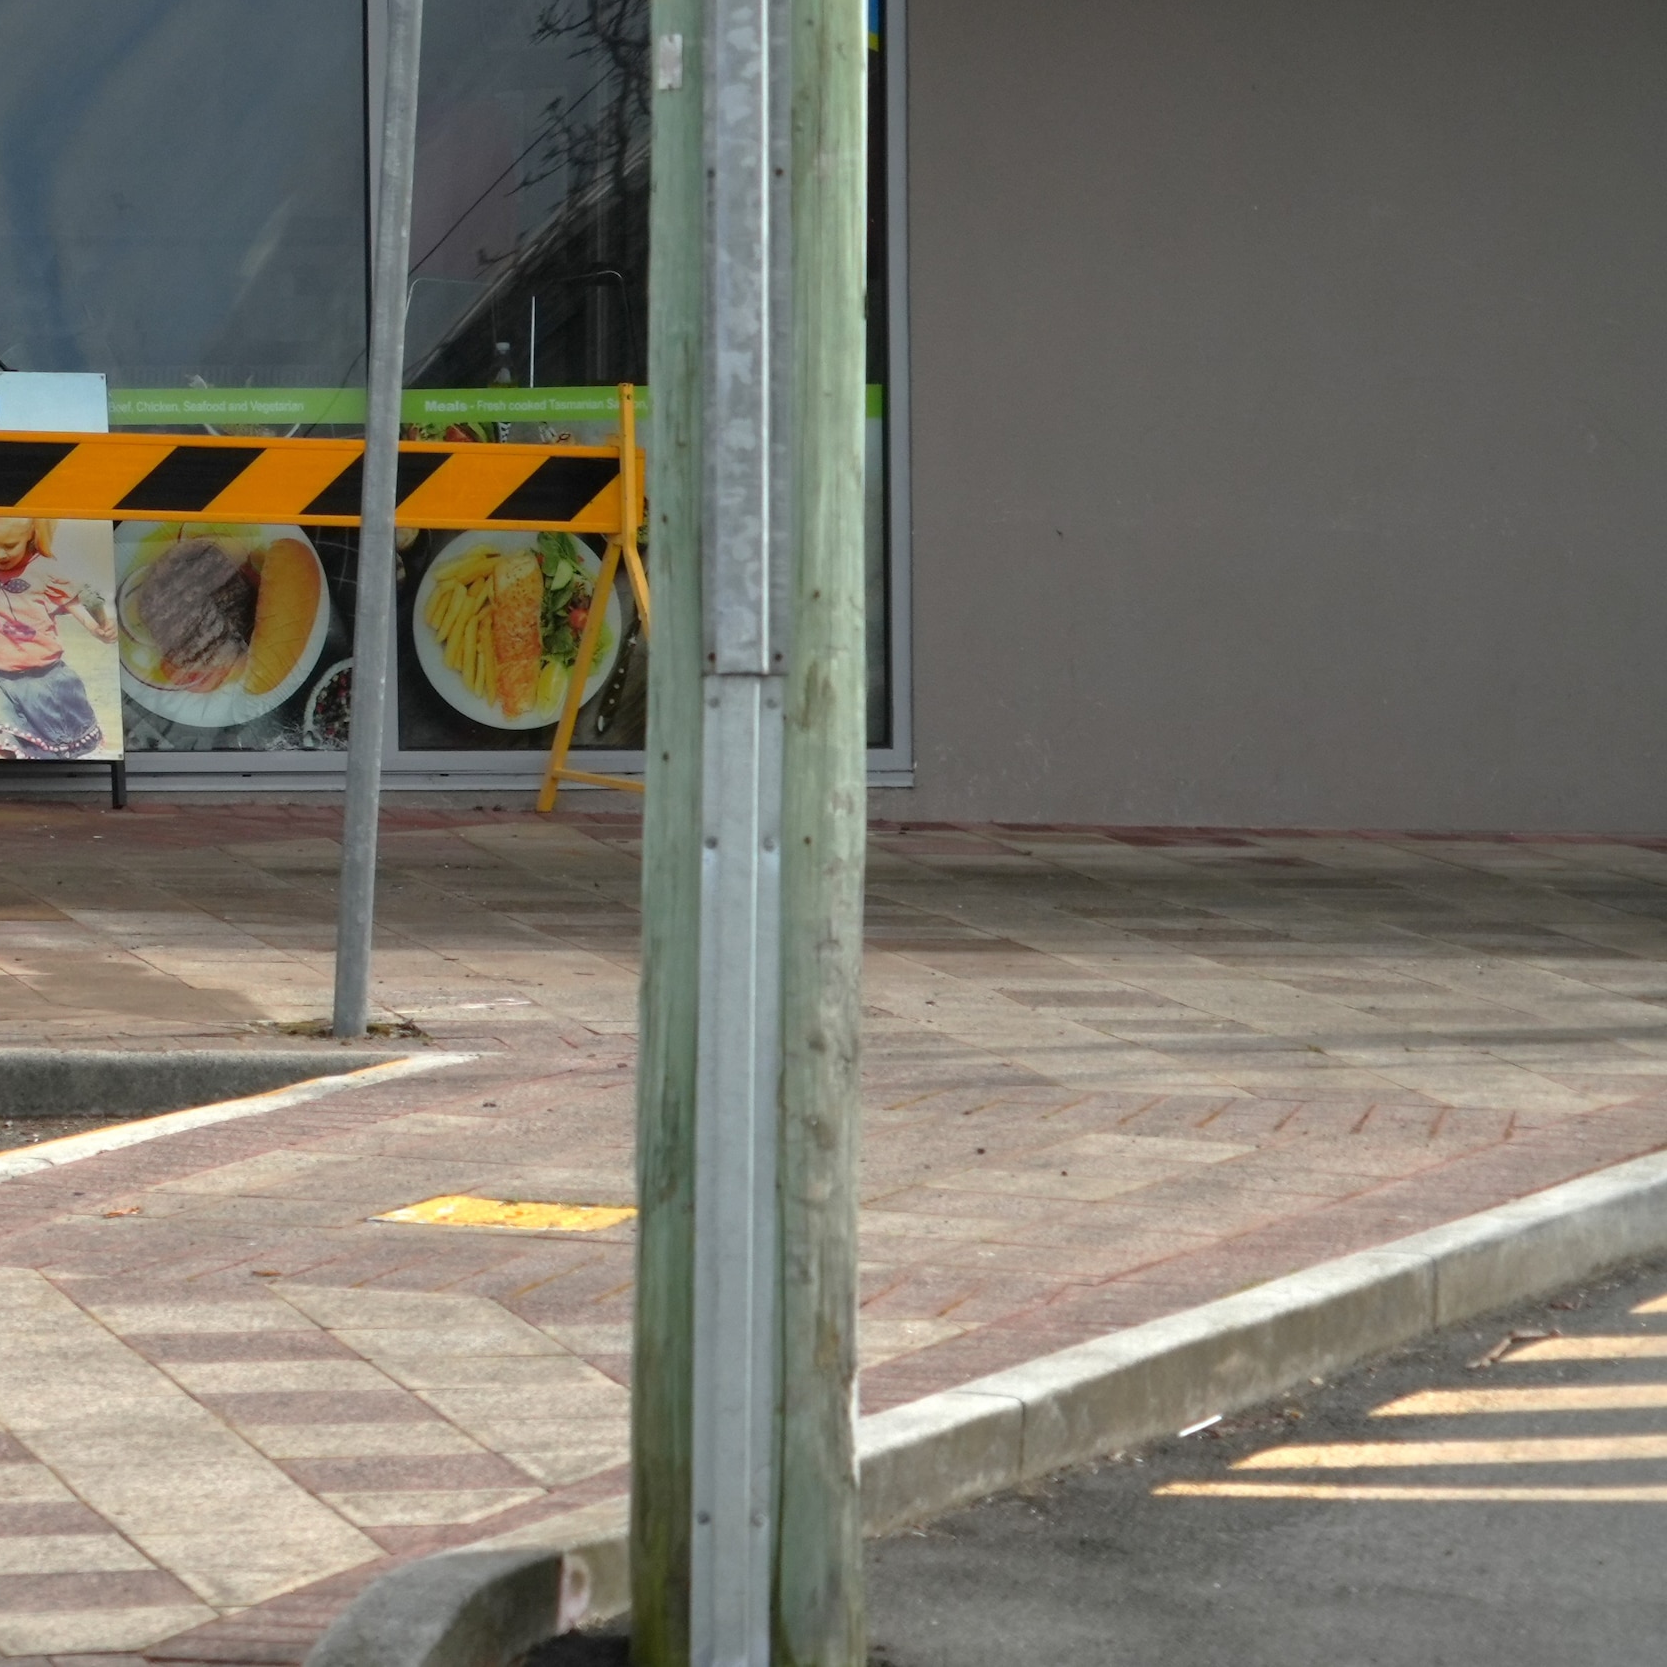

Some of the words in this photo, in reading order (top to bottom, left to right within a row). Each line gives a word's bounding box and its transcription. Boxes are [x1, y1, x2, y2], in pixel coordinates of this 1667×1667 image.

[137, 400, 180, 414] Chicken,
[183, 400, 226, 413] Seafood
[228, 400, 248, 413] and
[249, 400, 304, 415] Vegetarian
[424, 400, 467, 413] Meals
[476, 399, 506, 412] Fresh
[508, 399, 547, 412] cooked
[548, 398, 603, 412] Tasmanian
